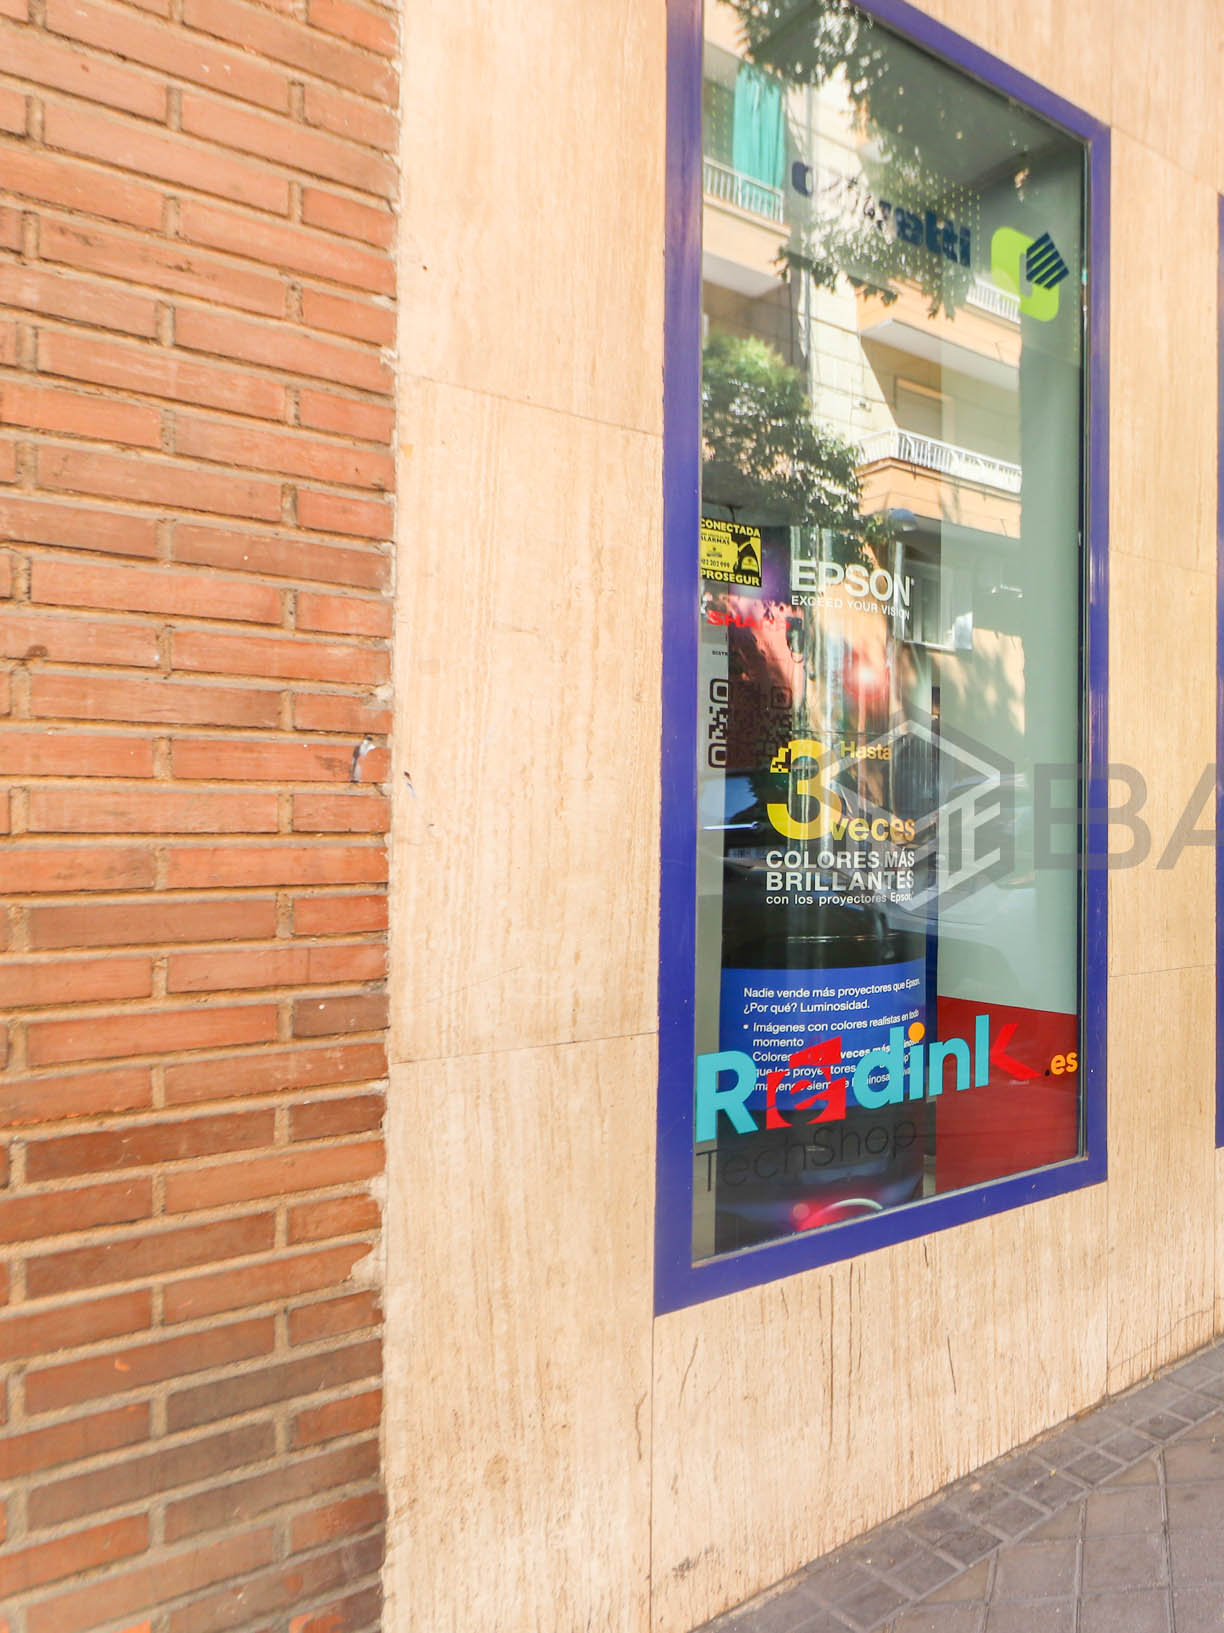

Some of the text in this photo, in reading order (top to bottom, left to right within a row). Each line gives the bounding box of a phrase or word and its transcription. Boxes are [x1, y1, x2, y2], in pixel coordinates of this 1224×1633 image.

[701, 568, 761, 586] PROSEGUR
[791, 559, 911, 607] EPSON
[791, 595, 910, 620] EXCEED YOUR VISION
[840, 740, 892, 761] Hasta
[766, 738, 843, 841] 3
[831, 817, 916, 842] veces
[765, 848, 915, 870] COLORES MÁS
[766, 870, 915, 892] BRILLANTES
[766, 896, 789, 905] con
[795, 894, 813, 905] los
[819, 893, 887, 907] proyectores
[744, 987, 775, 998] Nadie
[777, 987, 810, 998] vende
[812, 986, 836, 997] más
[837, 983, 892, 999] proyectores
[893, 981, 906, 992] que
[743, 1000, 870, 1015] ¿Por qué? Luminosidad.
[753, 1022, 806, 1035] Imágenes
[808, 1023, 829, 1032] con
[831, 1020, 868, 1031] colores
[869, 1015, 901, 1027] realistas
[901, 1013, 909, 1021] en
[753, 1038, 804, 1047] momento
[840, 1048, 870, 1059] veces
[793, 1065, 857, 1078] proyetores
[695, 1119, 918, 1192] TechShop
